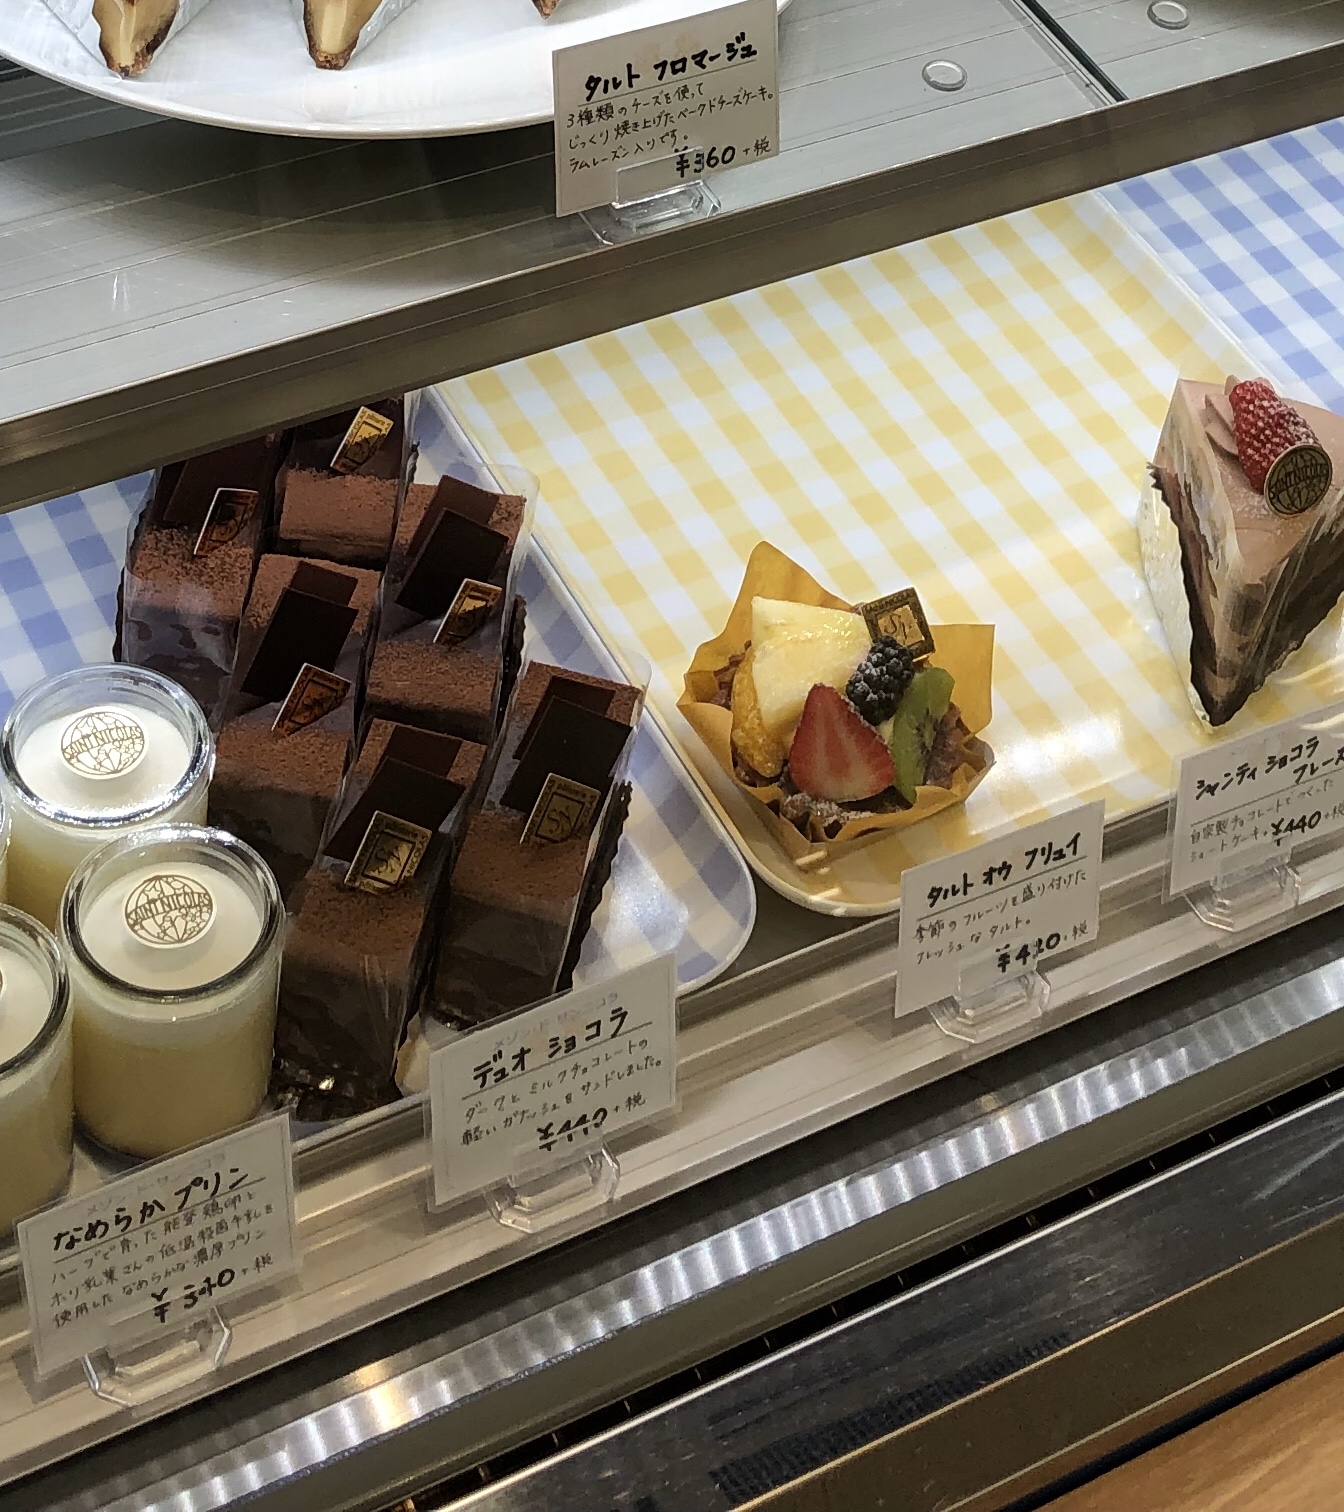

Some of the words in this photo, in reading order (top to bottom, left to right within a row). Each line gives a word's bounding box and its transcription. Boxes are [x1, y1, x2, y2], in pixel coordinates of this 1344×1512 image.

[585, 63, 640, 101] タルト
[654, 32, 757, 81] フロマージュ
[567, 82, 704, 128] 3種類のチーズを使って
[569, 129, 688, 173] ラムレーズン入りです。
[674, 145, 736, 178] ¥360
[95, 725, 142, 745] NICOLAS
[1264, 733, 1320, 775] ショコラ
[1269, 801, 1322, 850] ¥440
[926, 868, 974, 910] タルト
[981, 857, 1013, 889] オウ
[1023, 829, 1081, 875] フリュイ
[161, 892, 211, 913] NICOLAS
[472, 1036, 532, 1093] デュオ
[547, 1002, 629, 1064] ショコラ
